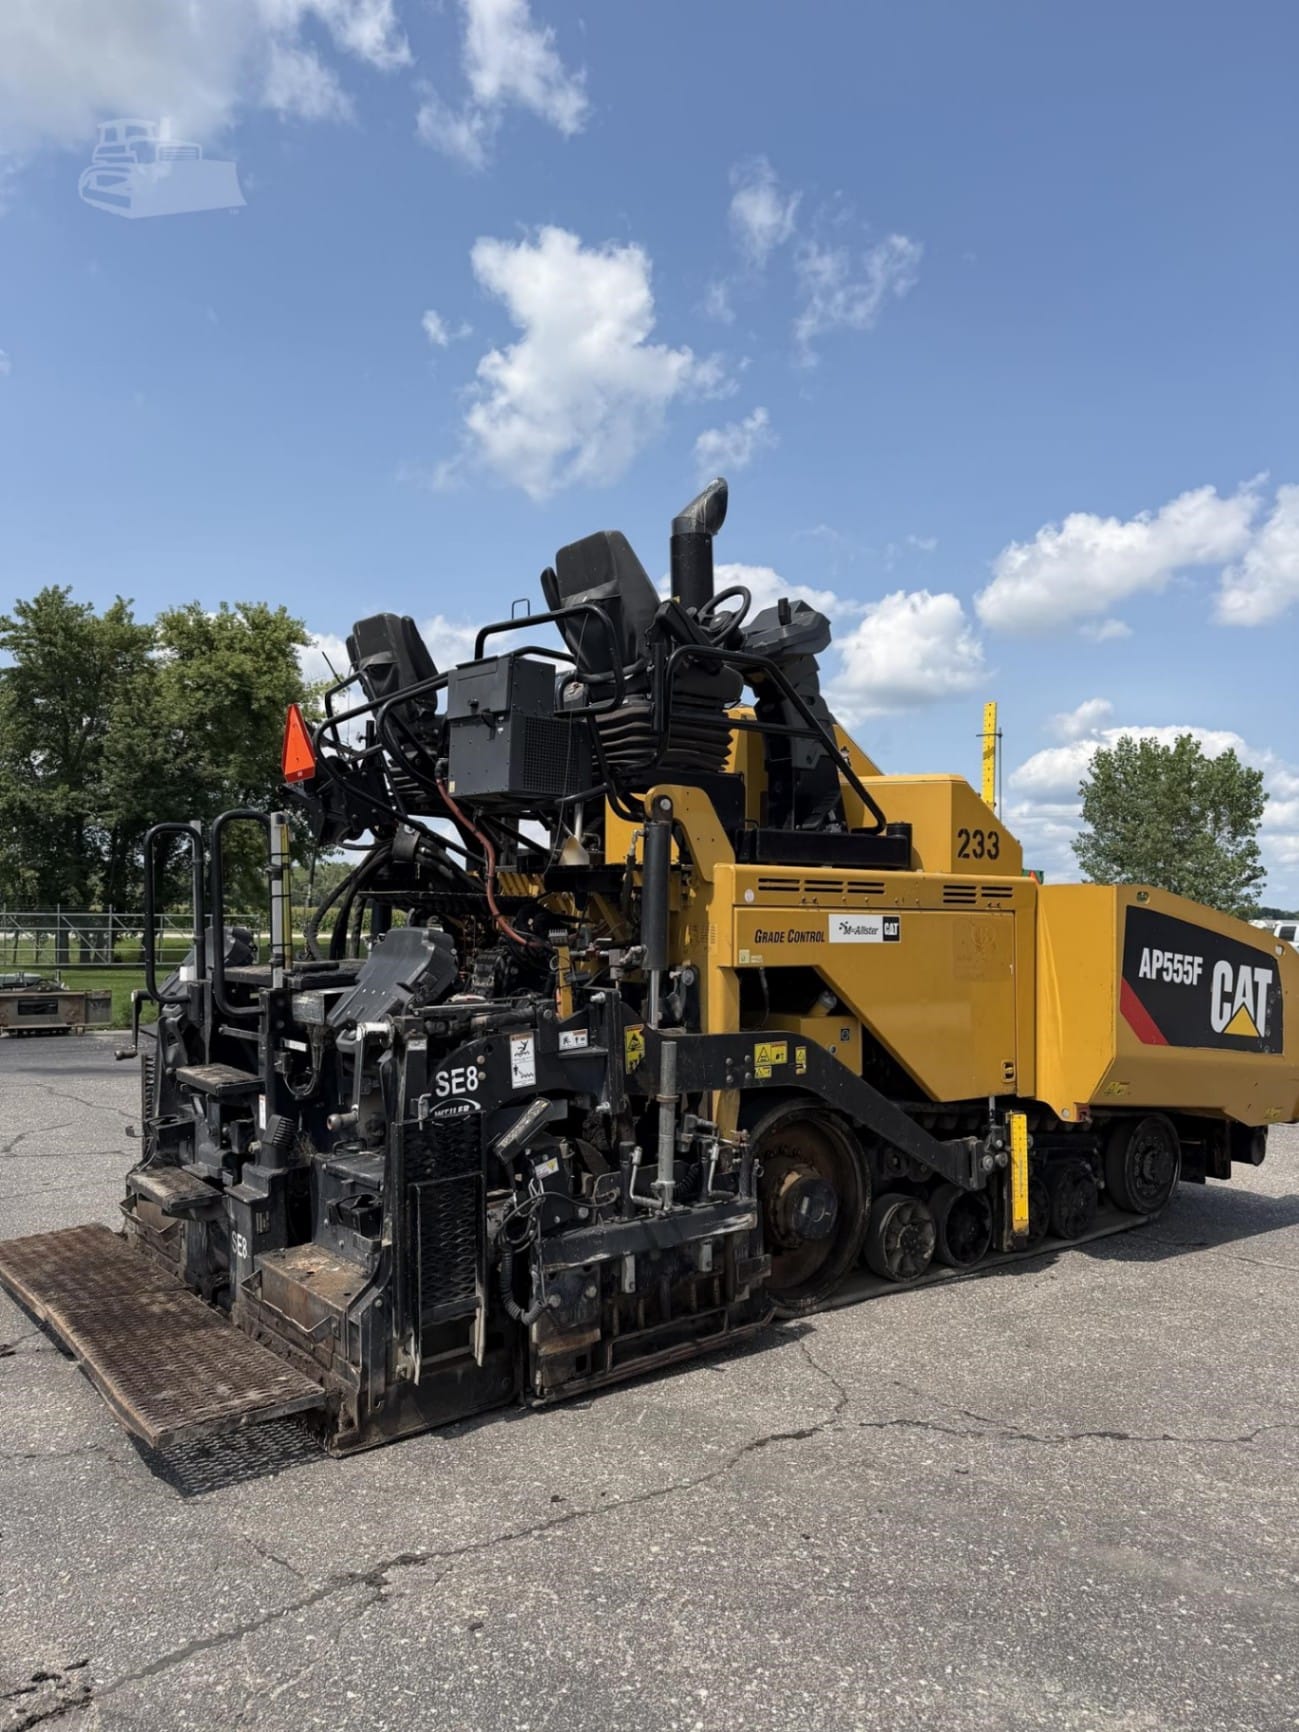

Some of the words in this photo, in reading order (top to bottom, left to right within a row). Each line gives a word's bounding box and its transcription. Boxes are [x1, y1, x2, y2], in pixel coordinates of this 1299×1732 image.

[957, 828, 999, 860] 233
[754, 929, 785, 944] GRADE
[787, 929, 825, 944] CONTROL
[1138, 947, 1204, 986] AP555F
[1210, 960, 1273, 1038] CAT
[435, 1065, 479, 1097] SE8
[231, 1230, 248, 1259] SE8
